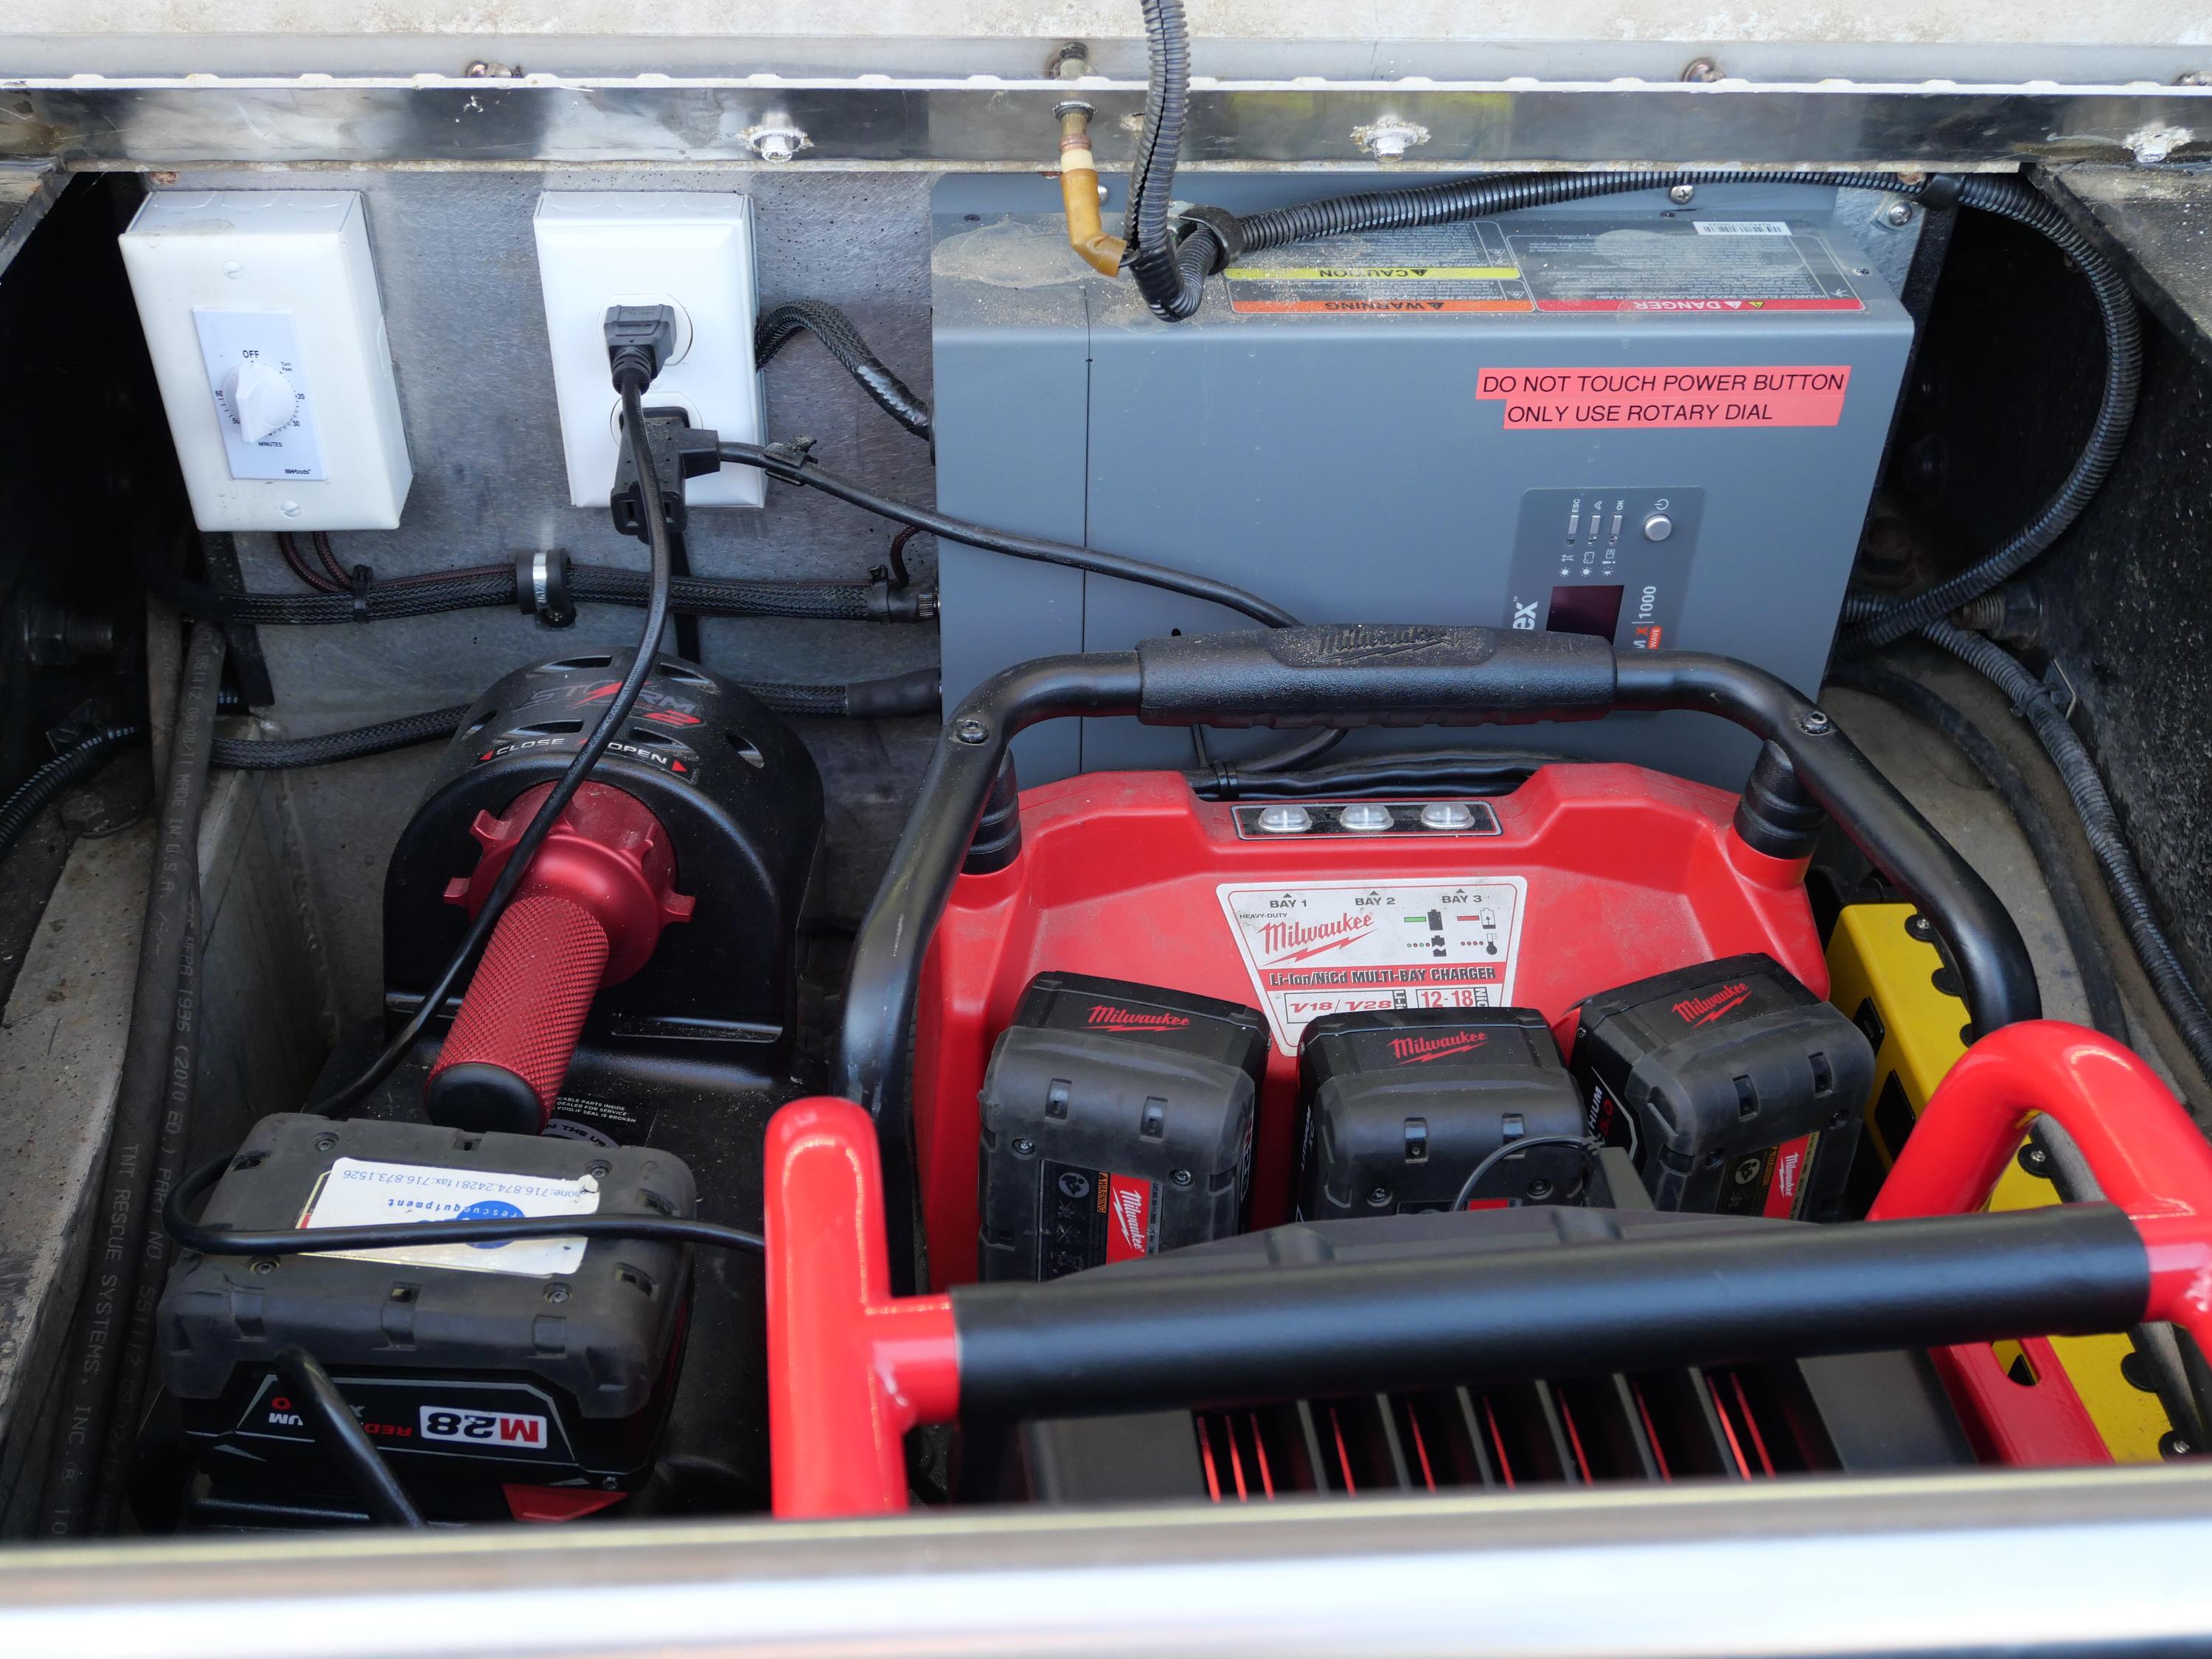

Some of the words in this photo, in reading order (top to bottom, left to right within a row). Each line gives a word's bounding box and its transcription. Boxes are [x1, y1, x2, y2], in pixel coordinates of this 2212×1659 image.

[1319, 269, 1408, 277] CAUTION
[1324, 302, 1425, 310] WARNING
[1635, 301, 1722, 310] DANGER
[243, 350, 260, 358] OFF
[1482, 375, 1517, 393] DO
[1523, 375, 1571, 393] NOT
[1577, 375, 1656, 392] TOUCH
[1663, 374, 1747, 391] POWER
[1753, 373, 1845, 390] BUTTON
[1507, 405, 1569, 422] ONLY
[1575, 405, 1621, 422] USE
[1627, 403, 1720, 421] ROTARY
[1725, 403, 1774, 420] DIAL
[1571, 498, 1580, 512] ESC
[1615, 500, 1624, 510] OK
[1638, 585, 1657, 619] 1000
[495, 738, 565, 756] CLOSE
[607, 741, 668, 765] OPEN
[1269, 900, 1296, 908] BAY
[1301, 899, 1308, 908] 1
[1354, 897, 1382, 906] BAY
[1385, 897, 1396, 905] 2
[1441, 895, 1469, 904] BAY
[1472, 894, 1482, 903] 3
[1268, 971, 1349, 987] Li-Ion/NiCd
[1351, 968, 1427, 984] MULTI-BAY
[1430, 967, 1497, 981] CHARGER
[1671, 981, 1750, 1025] Milwaukee
[1085, 1005, 1191, 1028] Milwaukee
[1387, 1031, 1488, 1060] Milwaukee
[608, 1114, 636, 1123] BROKEN
[119, 1144, 140, 1178] TNT
[1782, 1152, 1799, 1197] Milwaukee
[1096, 1179, 1107, 1213] WARNING
[105, 1189, 131, 1261] RESCUE
[1117, 1189, 1146, 1251] Milwaukee
[426, 1412, 540, 1443] M28
